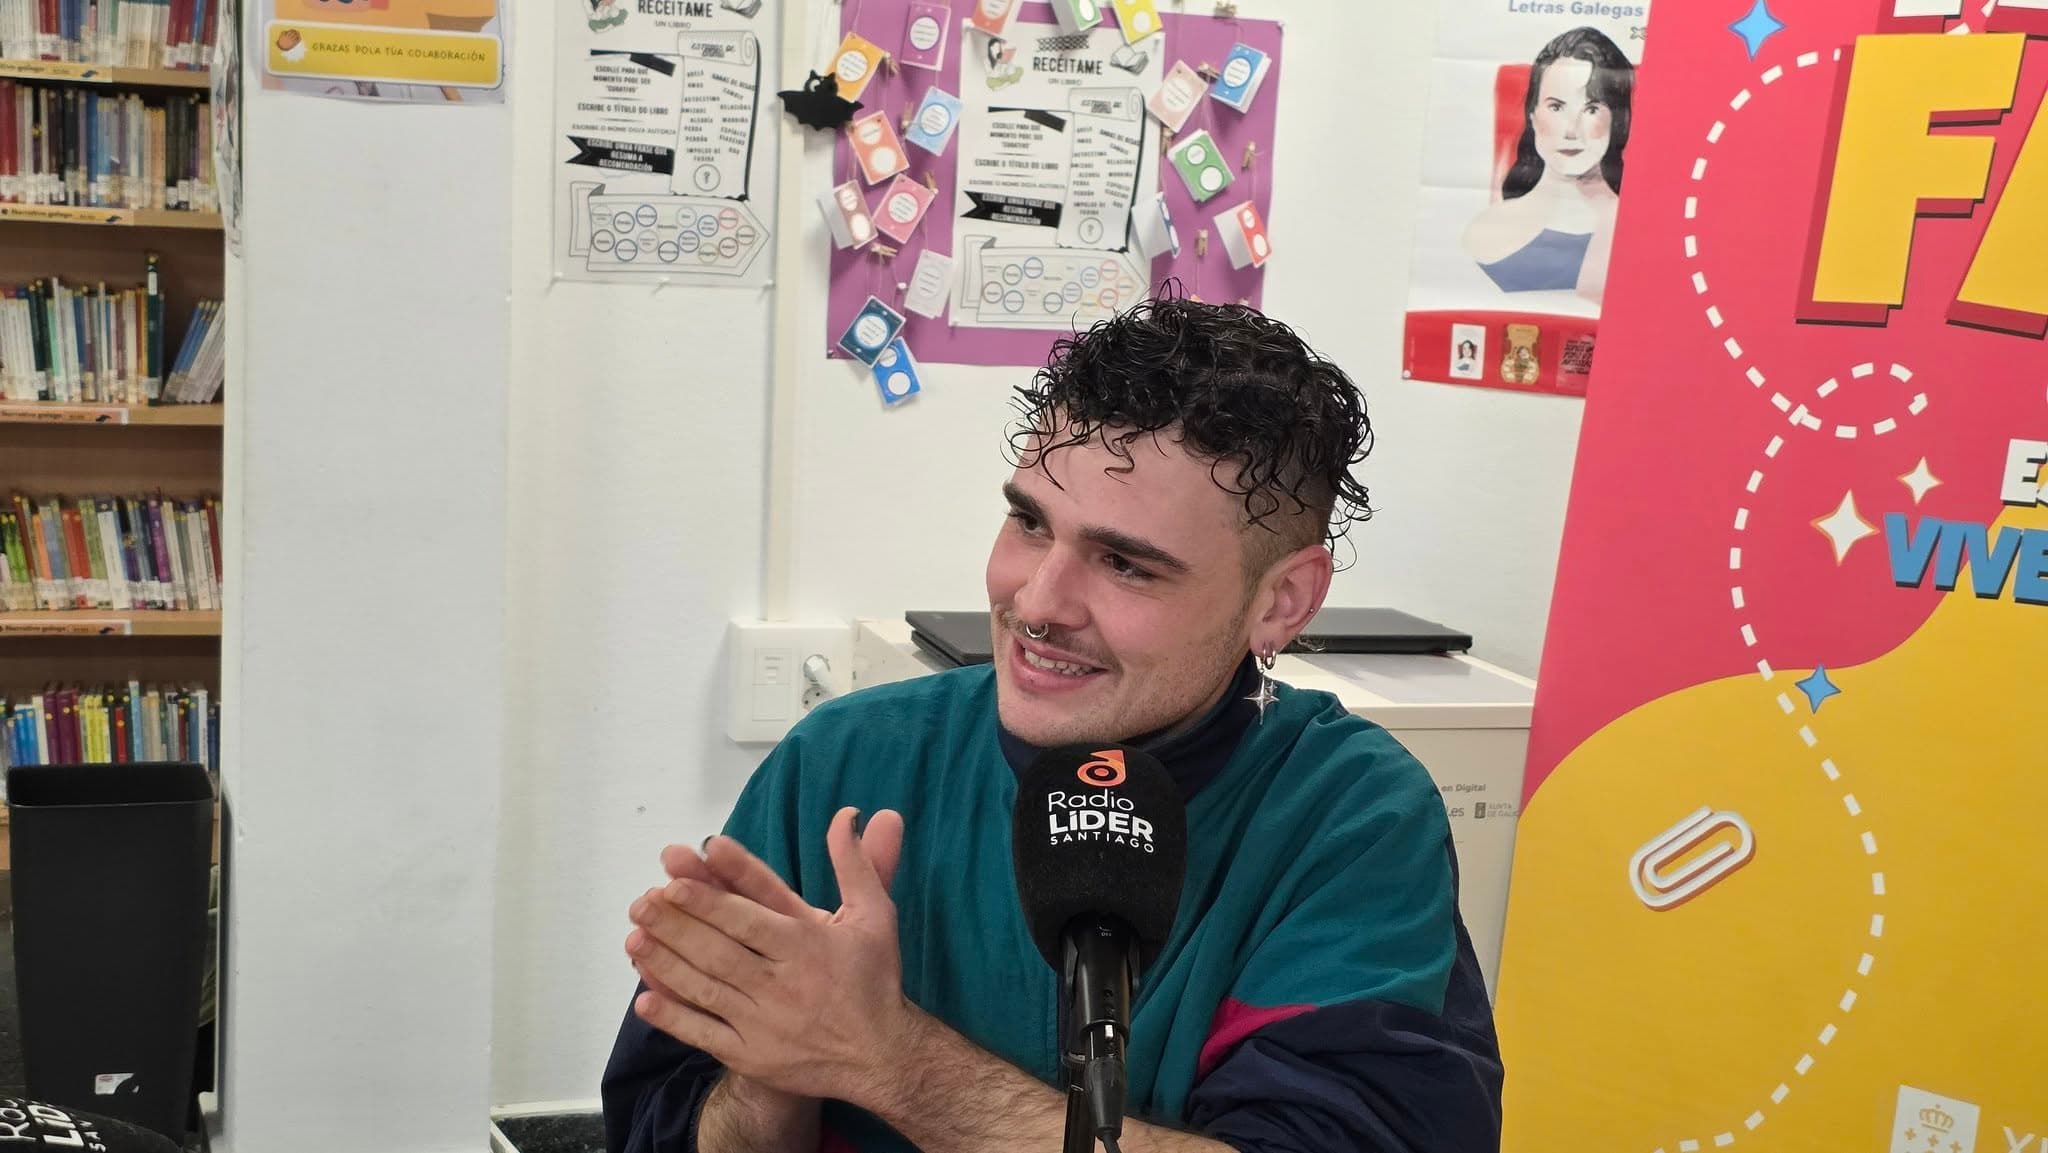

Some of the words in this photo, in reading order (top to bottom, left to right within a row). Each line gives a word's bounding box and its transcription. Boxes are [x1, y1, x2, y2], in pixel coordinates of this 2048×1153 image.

[1508, 0, 1564, 14] Letras
[1571, 1, 1645, 19] Galegas
[655, 20, 667, 28] UN
[669, 21, 692, 29] LIBRO
[312, 42, 350, 53] GRAZAS
[355, 44, 381, 56] POLA
[408, 48, 486, 62] COLABORACIÓN
[1441, 784, 1454, 792] en
[1455, 783, 1487, 793] Digital
[1048, 788, 1135, 812] Radio
[1051, 831, 1154, 853] SANTIAGO
[2002, 1126, 2048, 1153] X
